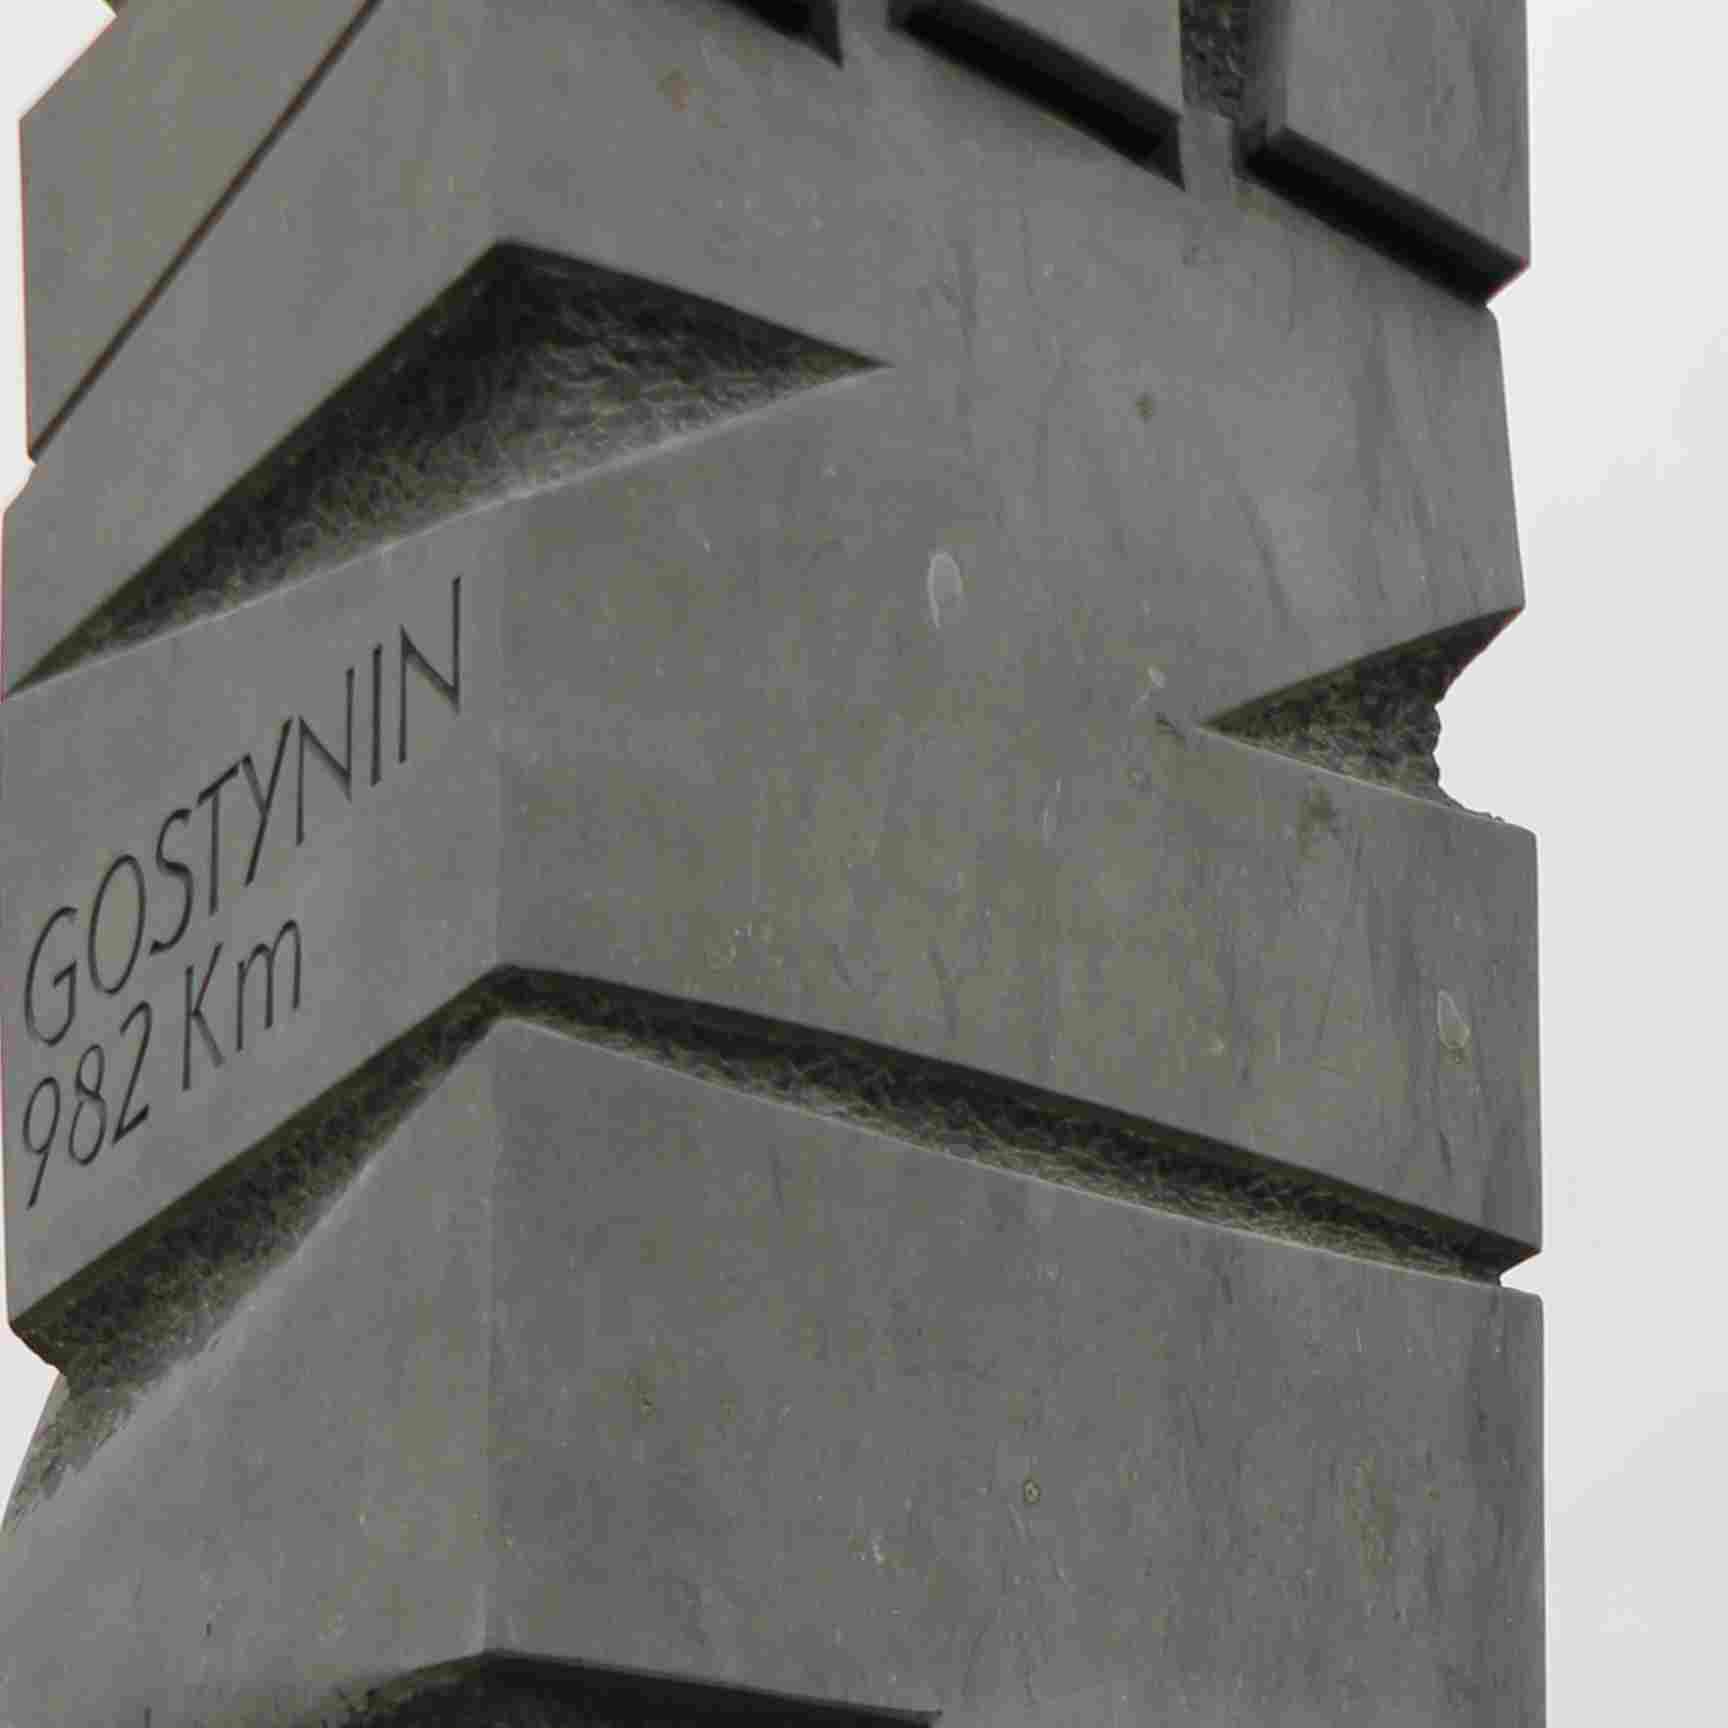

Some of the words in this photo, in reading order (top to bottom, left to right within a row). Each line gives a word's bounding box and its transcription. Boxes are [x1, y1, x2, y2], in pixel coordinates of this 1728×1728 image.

[24, 576, 462, 1047] GOSTYNIN
[22, 1001, 153, 1210] 982
[182, 919, 301, 1091] Km
